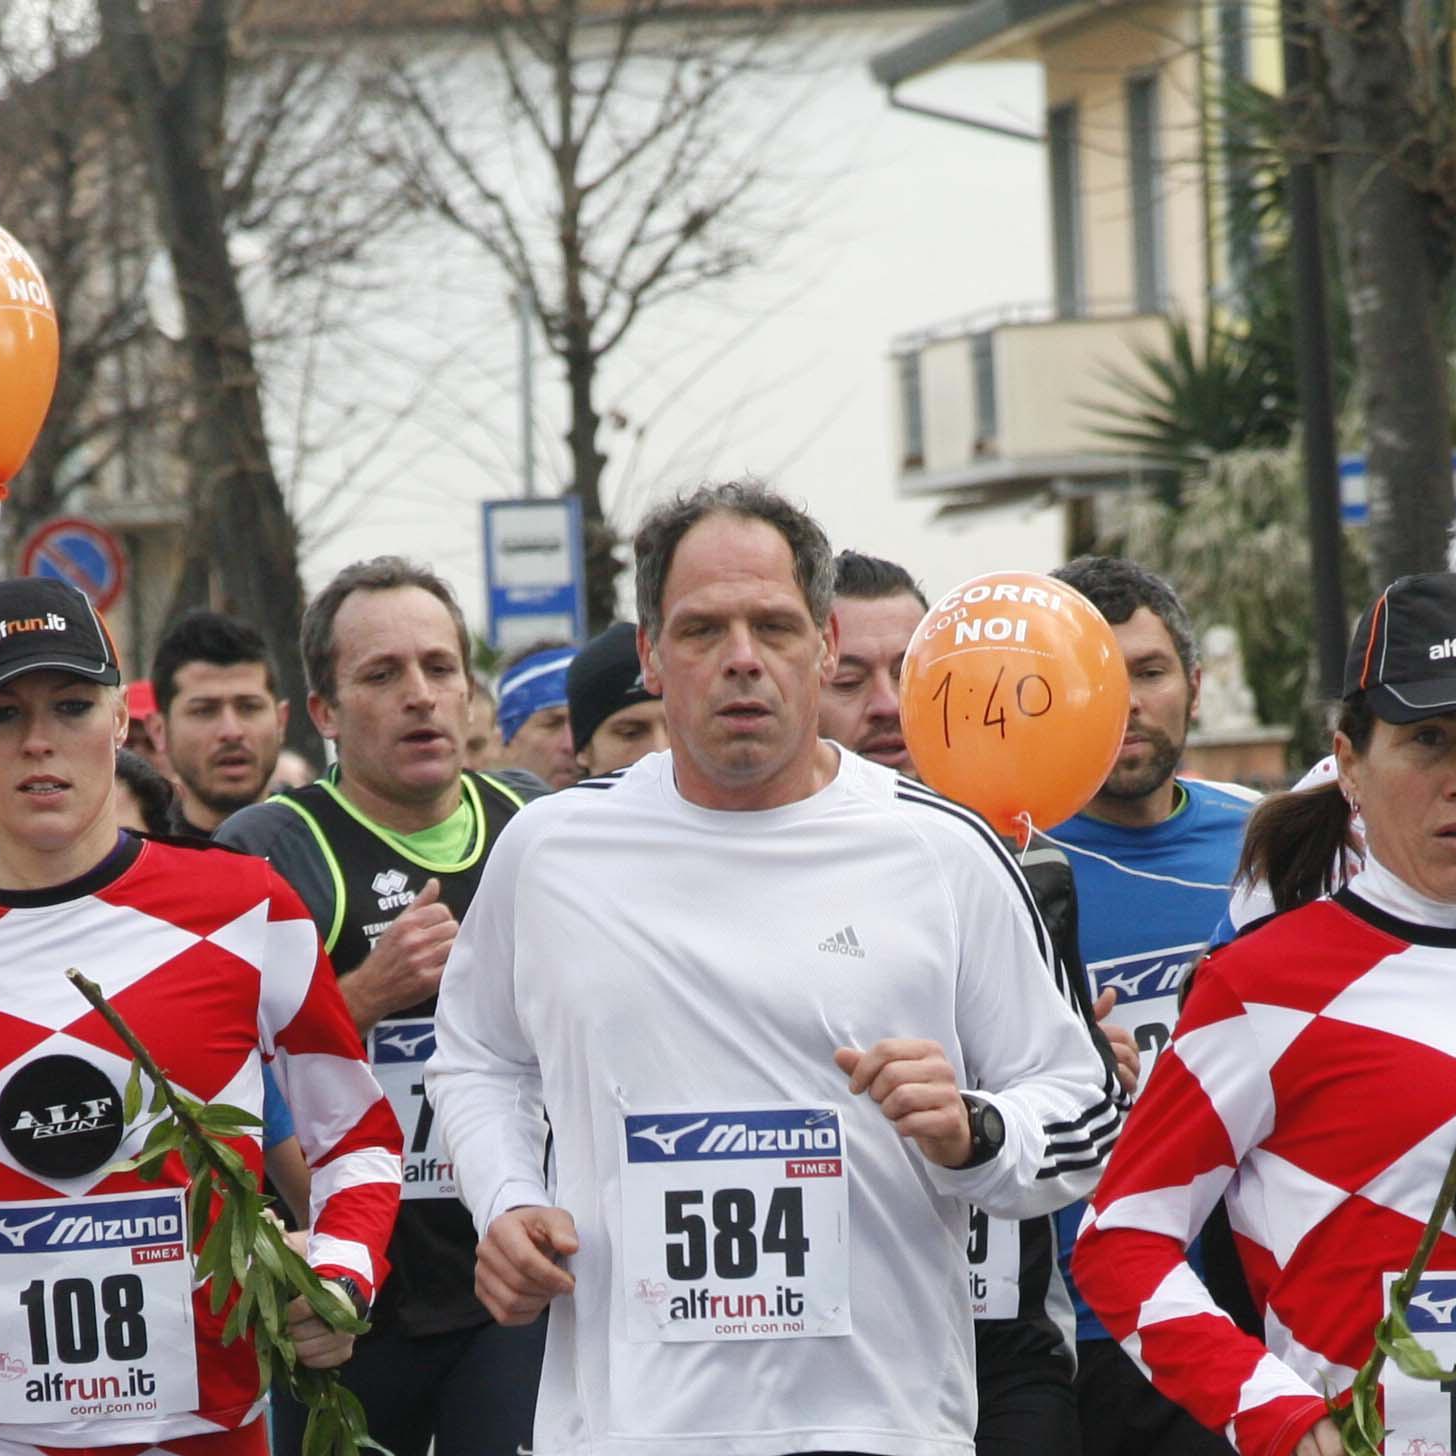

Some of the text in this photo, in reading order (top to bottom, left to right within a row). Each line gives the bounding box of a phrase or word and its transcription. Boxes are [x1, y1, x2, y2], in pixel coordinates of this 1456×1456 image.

[939, 584, 1061, 612] CORRI
[924, 607, 969, 640] con
[954, 617, 1028, 646] NOI
[932, 666, 1052, 749] 1:40
[818, 940, 865, 959] adidas
[10, 1097, 112, 1131] ALF
[32, 1118, 99, 1139] RUN
[792, 1163, 837, 1174] TIMEX
[664, 1186, 810, 1281] 584
[136, 1248, 180, 1261] TIMEX
[670, 1286, 804, 1320] alfrun.it
[19, 1273, 148, 1365] 108
[715, 1320, 804, 1334] corri con noi
[26, 1367, 156, 1402] alfrun.it
[71, 1399, 157, 1415] corri con noi
